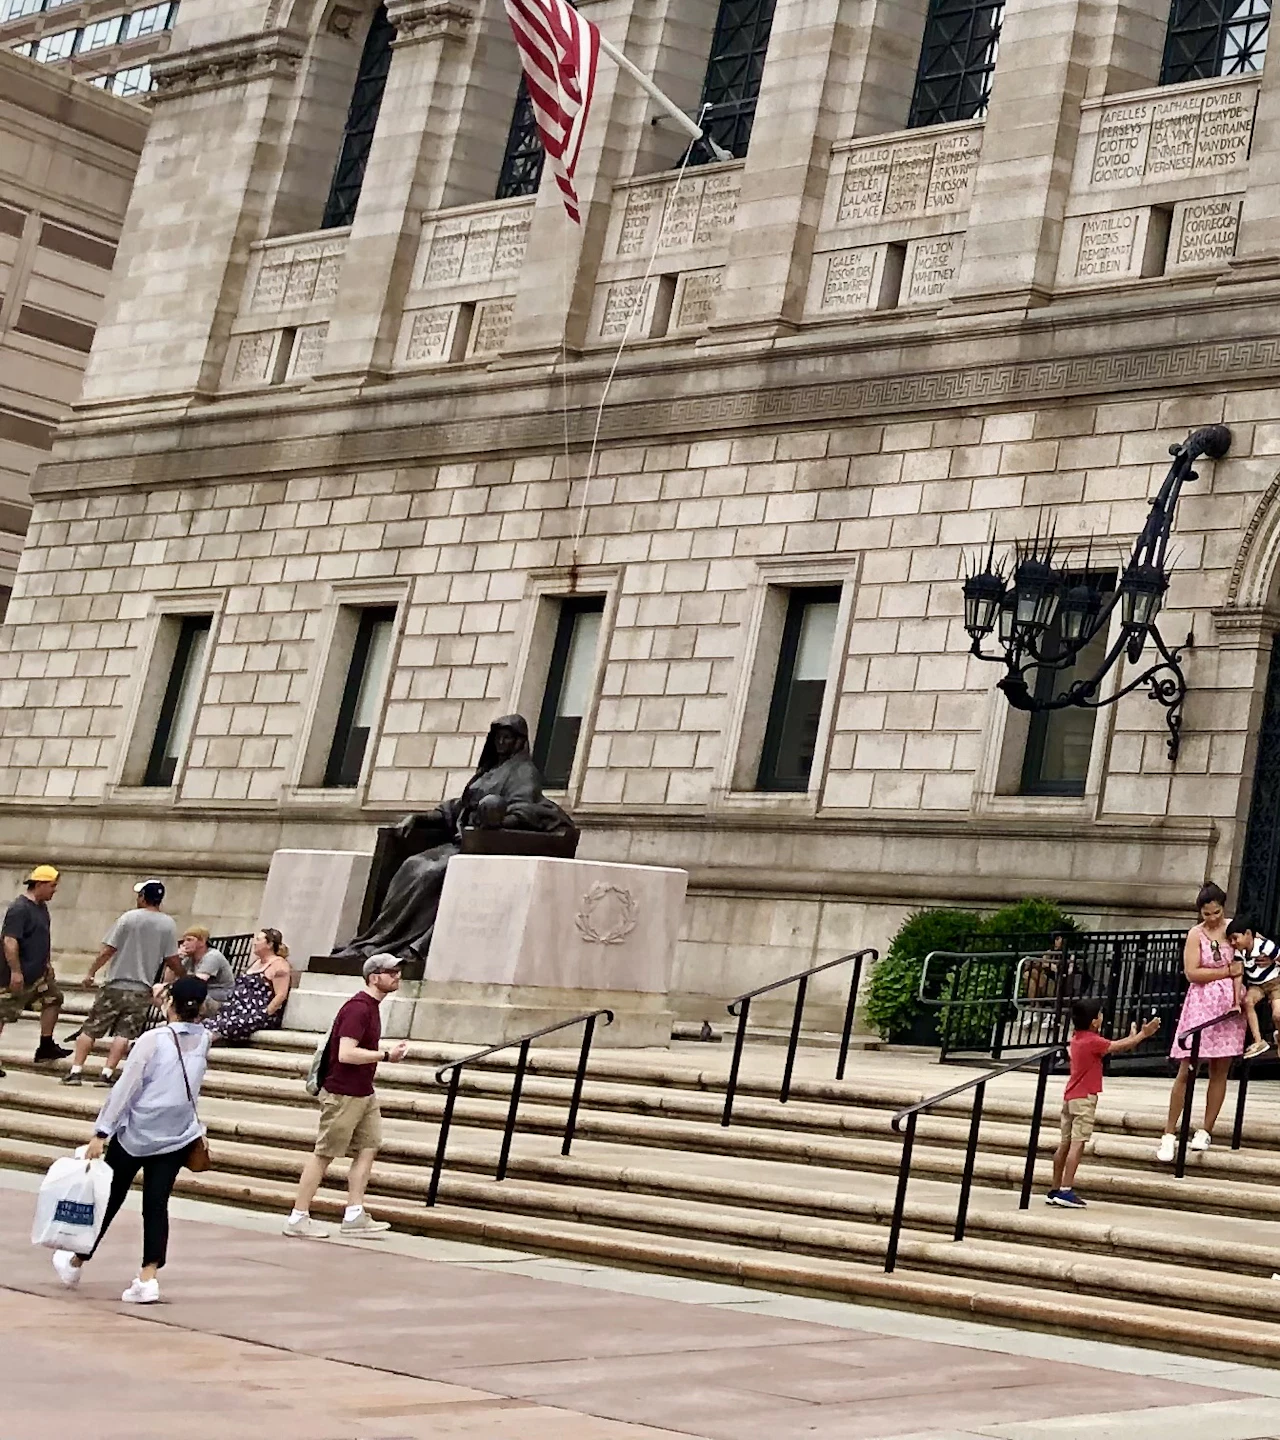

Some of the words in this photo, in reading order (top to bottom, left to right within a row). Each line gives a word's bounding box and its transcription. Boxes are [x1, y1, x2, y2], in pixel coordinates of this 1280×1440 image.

[1157, 98, 1201, 114] RAPHAEL
[1206, 92, 1242, 107] DVRER
[1103, 106, 1146, 123] APELLES
[1100, 137, 1139, 153] GIOTTO
[851, 149, 889, 165] GALILEO
[1097, 153, 1130, 168] GVIDO
[1195, 151, 1236, 169] MATSYS
[1186, 202, 1231, 219] POVSSIN
[1080, 259, 1120, 276] HOLBEIN
